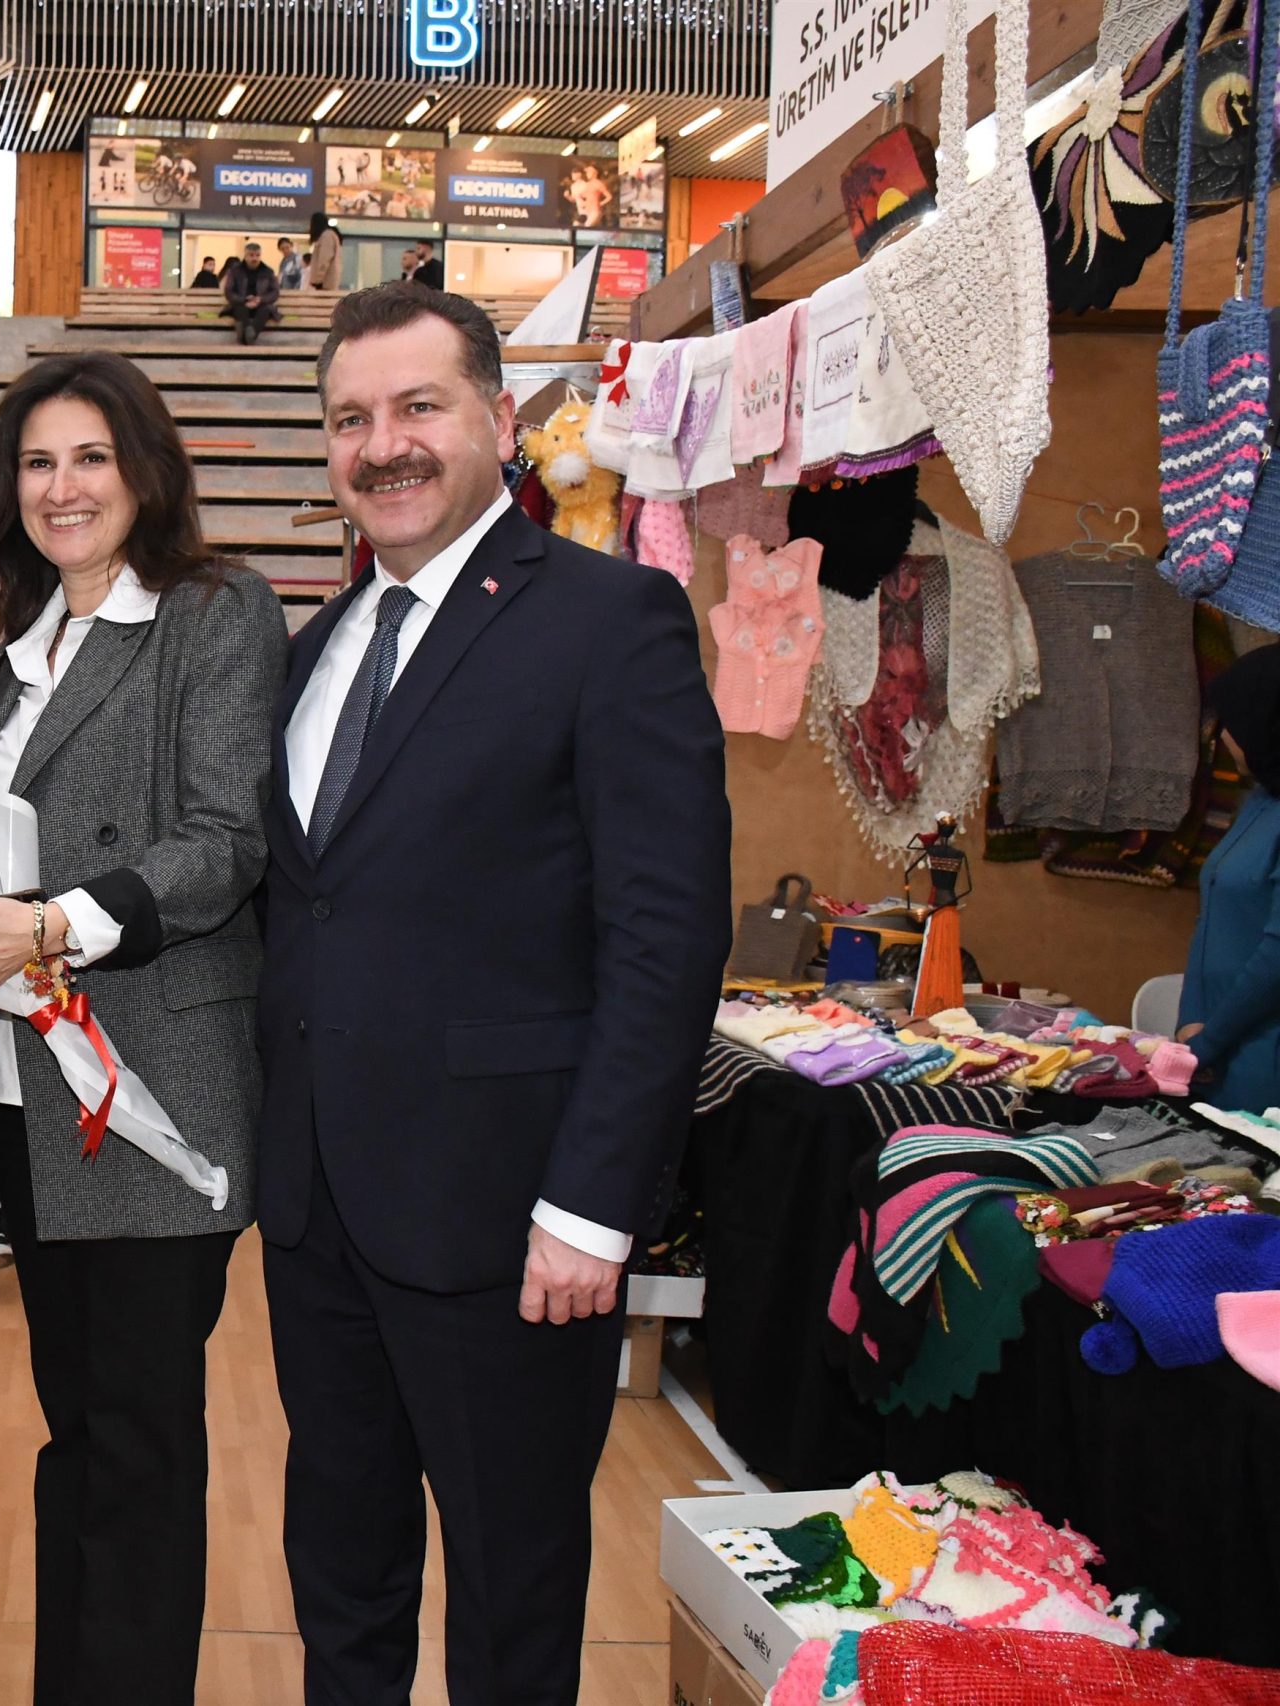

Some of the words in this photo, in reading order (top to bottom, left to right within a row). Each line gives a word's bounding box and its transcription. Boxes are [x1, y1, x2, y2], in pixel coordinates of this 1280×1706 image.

[410, 0, 478, 67] B
[799, 8, 828, 64] S.S.
[776, 53, 836, 138] ÜRETİM
[842, 28, 864, 82] VE
[869, 0, 934, 64] İŞLE
[220, 169, 308, 188] DECATHLON
[454, 180, 540, 200] DECATHLON
[230, 195, 243, 206] B1
[245, 195, 296, 208] KATINDA
[464, 205, 477, 216] B1
[479, 206, 529, 218] KATINDA
